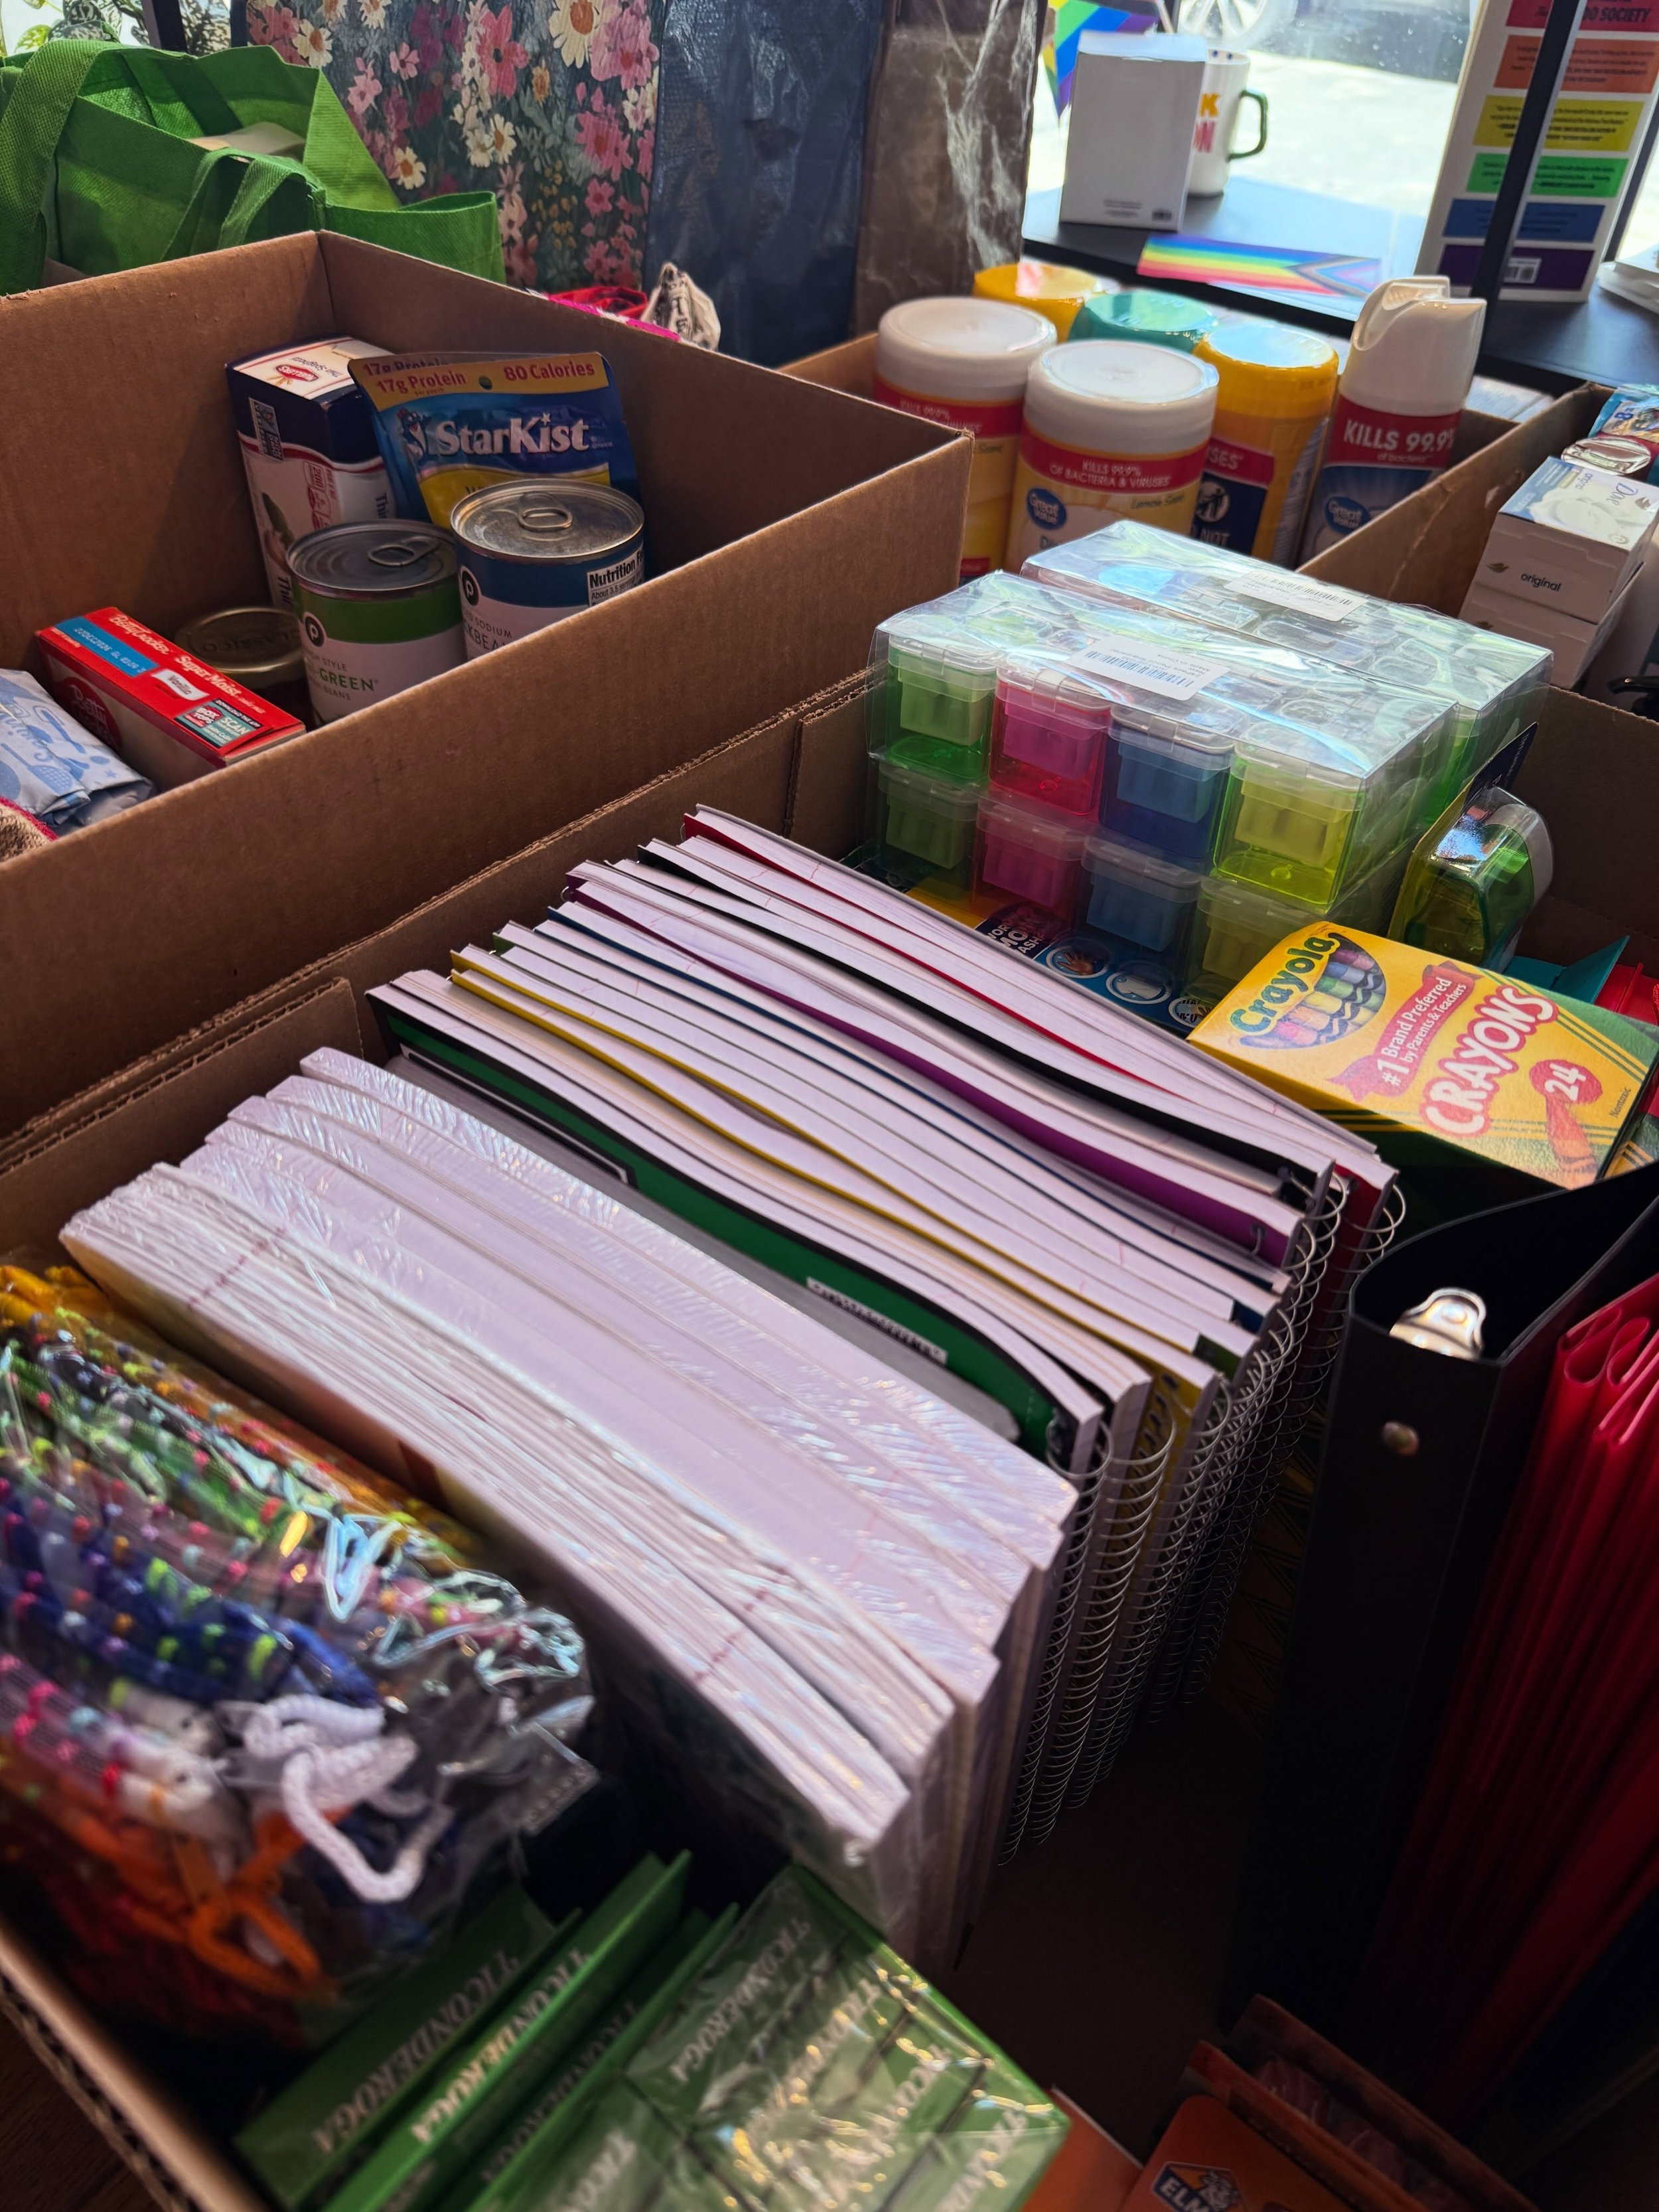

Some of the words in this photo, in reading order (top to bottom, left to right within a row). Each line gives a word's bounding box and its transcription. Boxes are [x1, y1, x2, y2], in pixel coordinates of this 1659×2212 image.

[1599, 7, 1650, 23] SOCIETY
[376, 378, 409, 394] 17g
[407, 369, 467, 390] Protein
[503, 365, 529, 382] 80
[530, 360, 596, 380] Calories
[434, 412, 590, 456] StarKist
[1343, 419, 1400, 451] KILLS
[1049, 463, 1063, 476] OF
[1064, 467, 1116, 488] BACTERIA
[1118, 477, 1127, 488] &
[1129, 475, 1173, 489] VIRUSES
[1082, 458, 1110, 476] KILLS
[1111, 464, 1141, 478] 99.9%
[1029, 493, 1059, 516] Great
[1605, 481, 1639, 506] Dove
[589, 558, 636, 589] Nutrition
[1520, 573, 1561, 592] original
[591, 589, 609, 601] About
[609, 585, 619, 597] 3.5
[474, 617, 513, 640] SODIUM
[175, 655, 211, 682] Super
[208, 674, 242, 697] Moist
[322, 656, 348, 672] STYLE
[167, 675, 192, 696] Vanilla
[192, 712, 216, 725] TOPS
[196, 706, 221, 719] BOX
[220, 717, 251, 735] SCAN
[1230, 936, 1336, 1033] Crayola
[1401, 976, 1453, 1024] Preferred
[1432, 982, 1467, 1015] Teachers
[1427, 1011, 1441, 1021] &
[1380, 1019, 1413, 1058] Brand
[1406, 1017, 1435, 1052] Parents
[1399, 1051, 1418, 1063] by
[1425, 986, 1555, 1136] CRAYONS
[1377, 1057, 1410, 1087] #1
[1544, 1062, 1587, 1102] 24
[312, 1949, 520, 2154] TICONDEROGA
